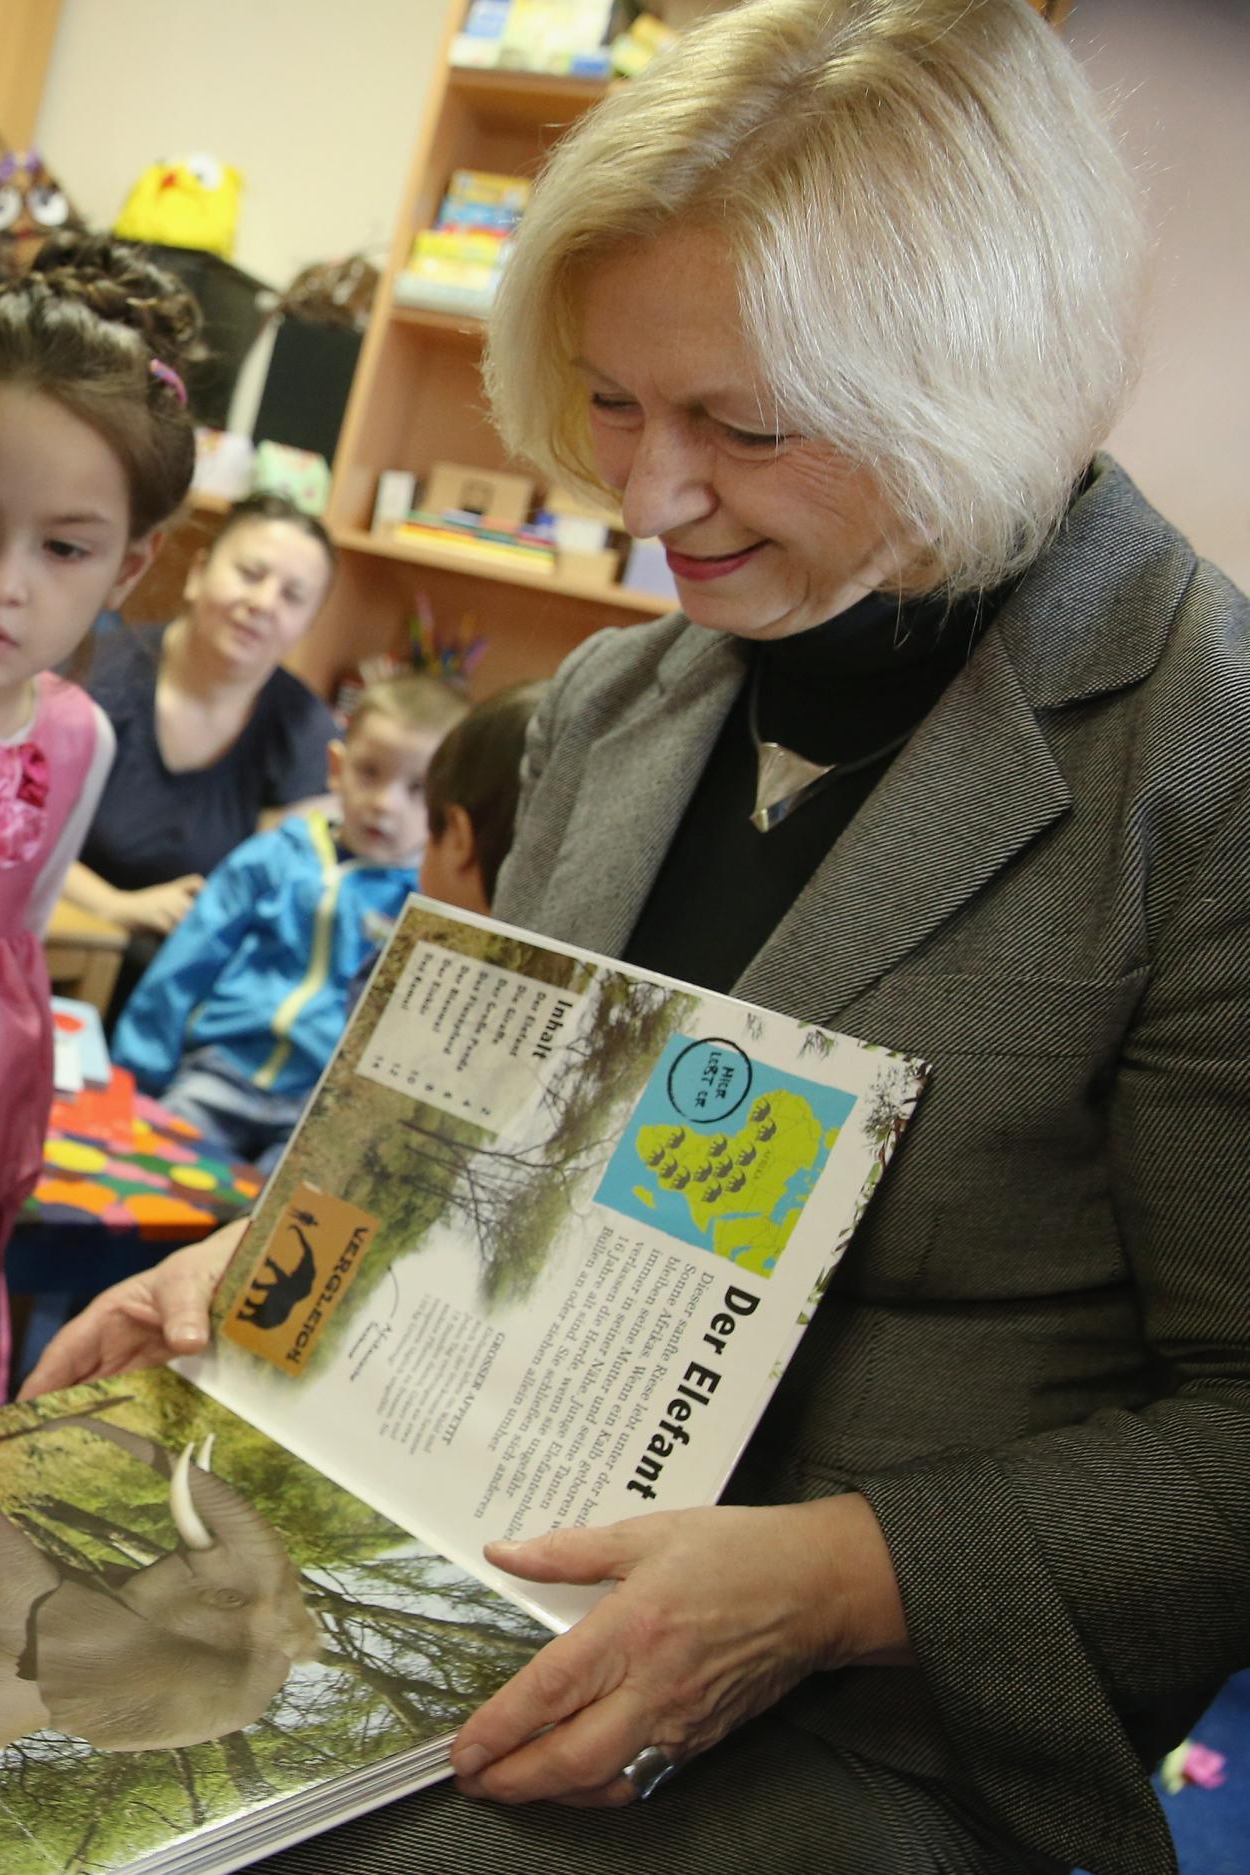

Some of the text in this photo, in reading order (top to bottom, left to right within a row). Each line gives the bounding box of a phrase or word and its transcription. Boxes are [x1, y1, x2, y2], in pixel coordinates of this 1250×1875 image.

[531, 998, 574, 1060] Inhalt
[584, 1225, 615, 1270] Bullen
[612, 1234, 630, 1253] 16
[573, 1269, 589, 1289] an
[592, 1249, 621, 1290] Jahre
[604, 1240, 646, 1304] verlassen
[630, 1247, 663, 1295] immer
[644, 1254, 681, 1307] bleiben
[666, 1262, 697, 1308] Sonne
[285, 1224, 369, 1365] VERGLEICH
[556, 1289, 580, 1322] oder
[582, 1290, 598, 1310] alt
[620, 1295, 636, 1312] in
[682, 1271, 715, 1319] Dieser
[593, 1304, 611, 1328] die
[597, 1312, 627, 1357] seiner
[625, 1307, 650, 1346] seine
[531, 1321, 562, 1367] ziehen
[550, 1344, 570, 1368] Sie
[660, 1318, 689, 1363] sanfte
[440, 1331, 506, 1447] GROSSER APPETIT
[511, 1366, 538, 1407] allein
[599, 1345, 633, 1395] Mutter
[616, 1363, 646, 1403] Wenn
[640, 1363, 668, 1402] Riese
[518, 1367, 557, 1434] schließen
[548, 1375, 573, 1414] wenn
[584, 1394, 606, 1425] und
[626, 1284, 760, 1503] Der Elefant
[537, 1415, 554, 1436] sie
[555, 1394, 585, 1440] Junge
[603, 1403, 623, 1428] ein
[623, 1402, 648, 1432] lebt
[501, 1432, 523, 1463] sich
[564, 1423, 590, 1463] seine
[587, 1428, 612, 1461] Kalb
[603, 1431, 631, 1472] unter
[503, 1436, 542, 1499] ungefähr
[538, 1463, 571, 1512] Tanten
[589, 1470, 611, 1498] der
[472, 1462, 507, 1520] anderen
[556, 1459, 593, 1519] geboren
